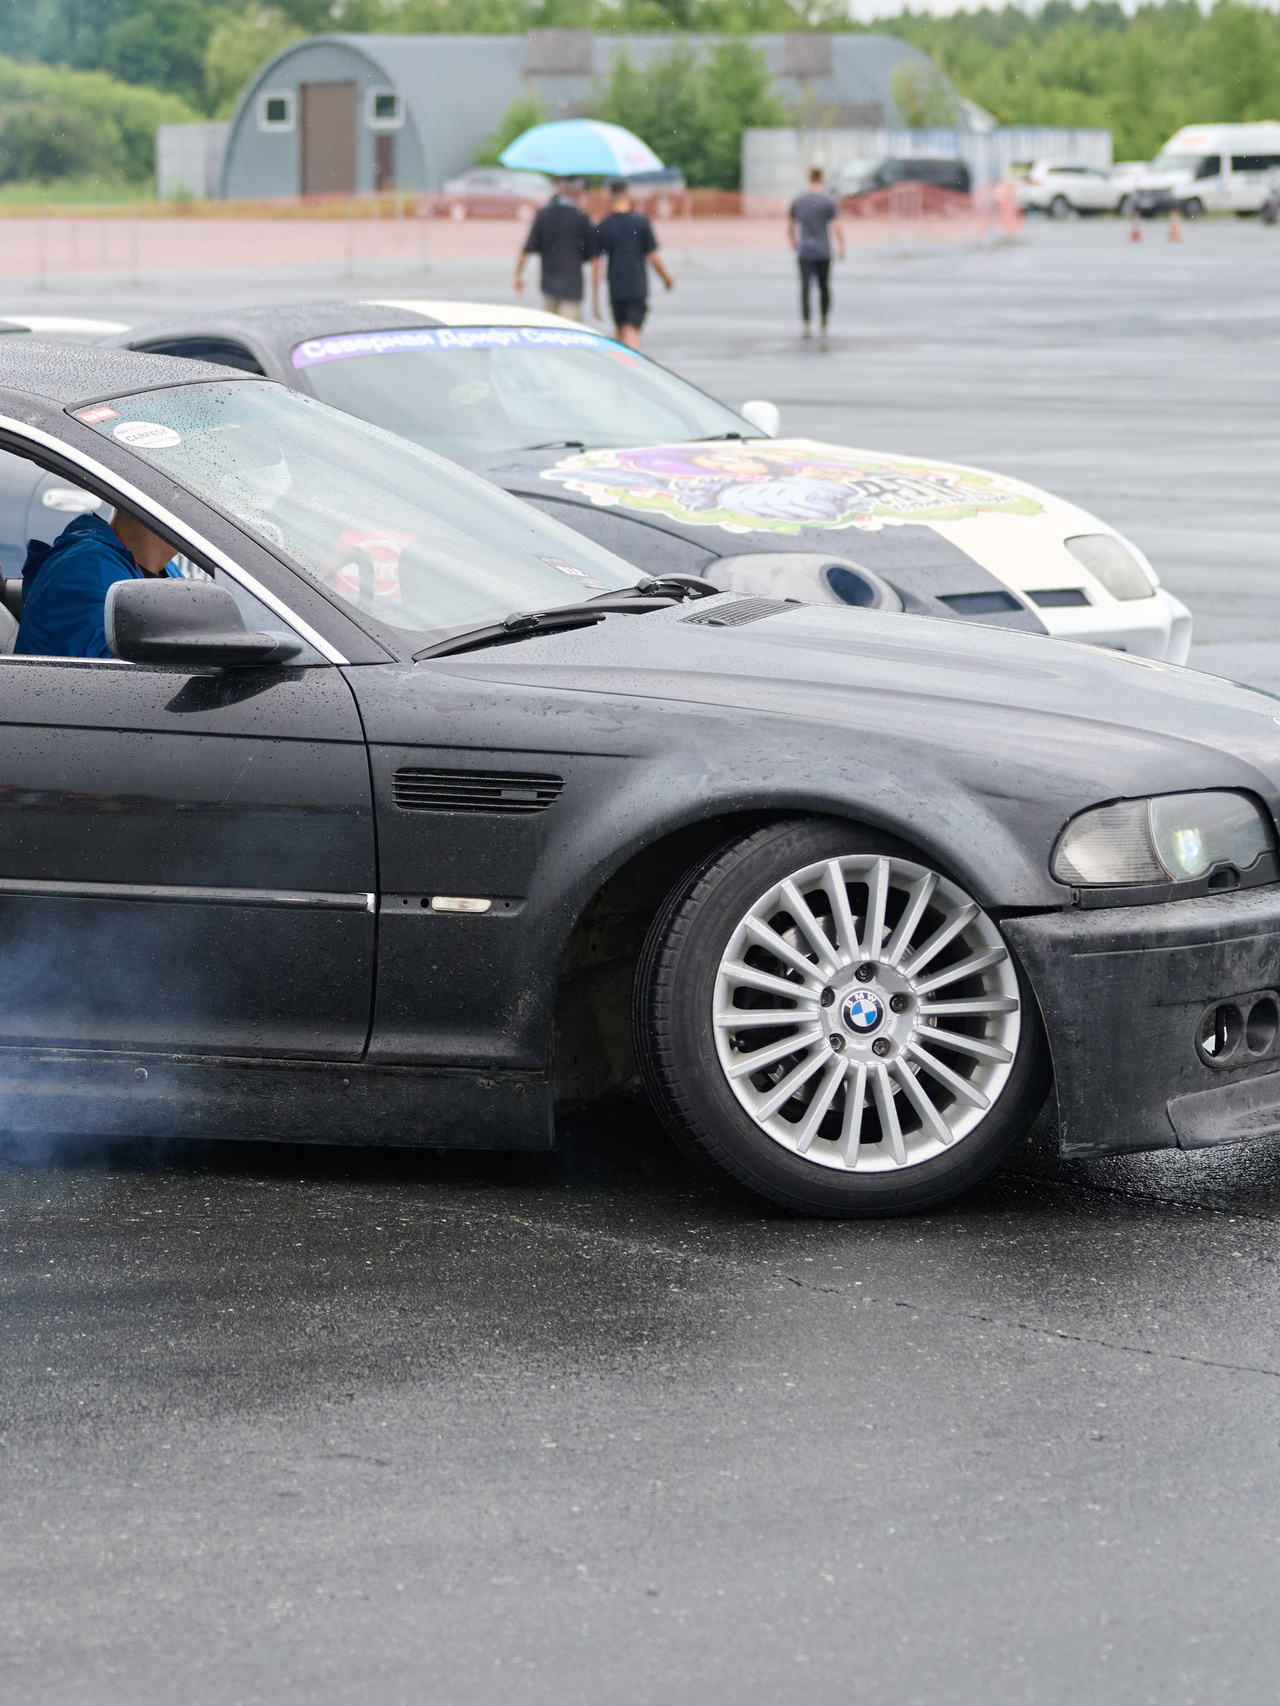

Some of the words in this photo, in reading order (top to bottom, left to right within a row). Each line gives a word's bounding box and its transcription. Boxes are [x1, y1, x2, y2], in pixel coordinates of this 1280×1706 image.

[302, 334, 434, 358] Северная
[437, 328, 520, 348] Дрифт
[521, 329, 600, 346] Серия
[125, 429, 168, 442] CARFEST
[845, 992, 877, 1009] BMW
